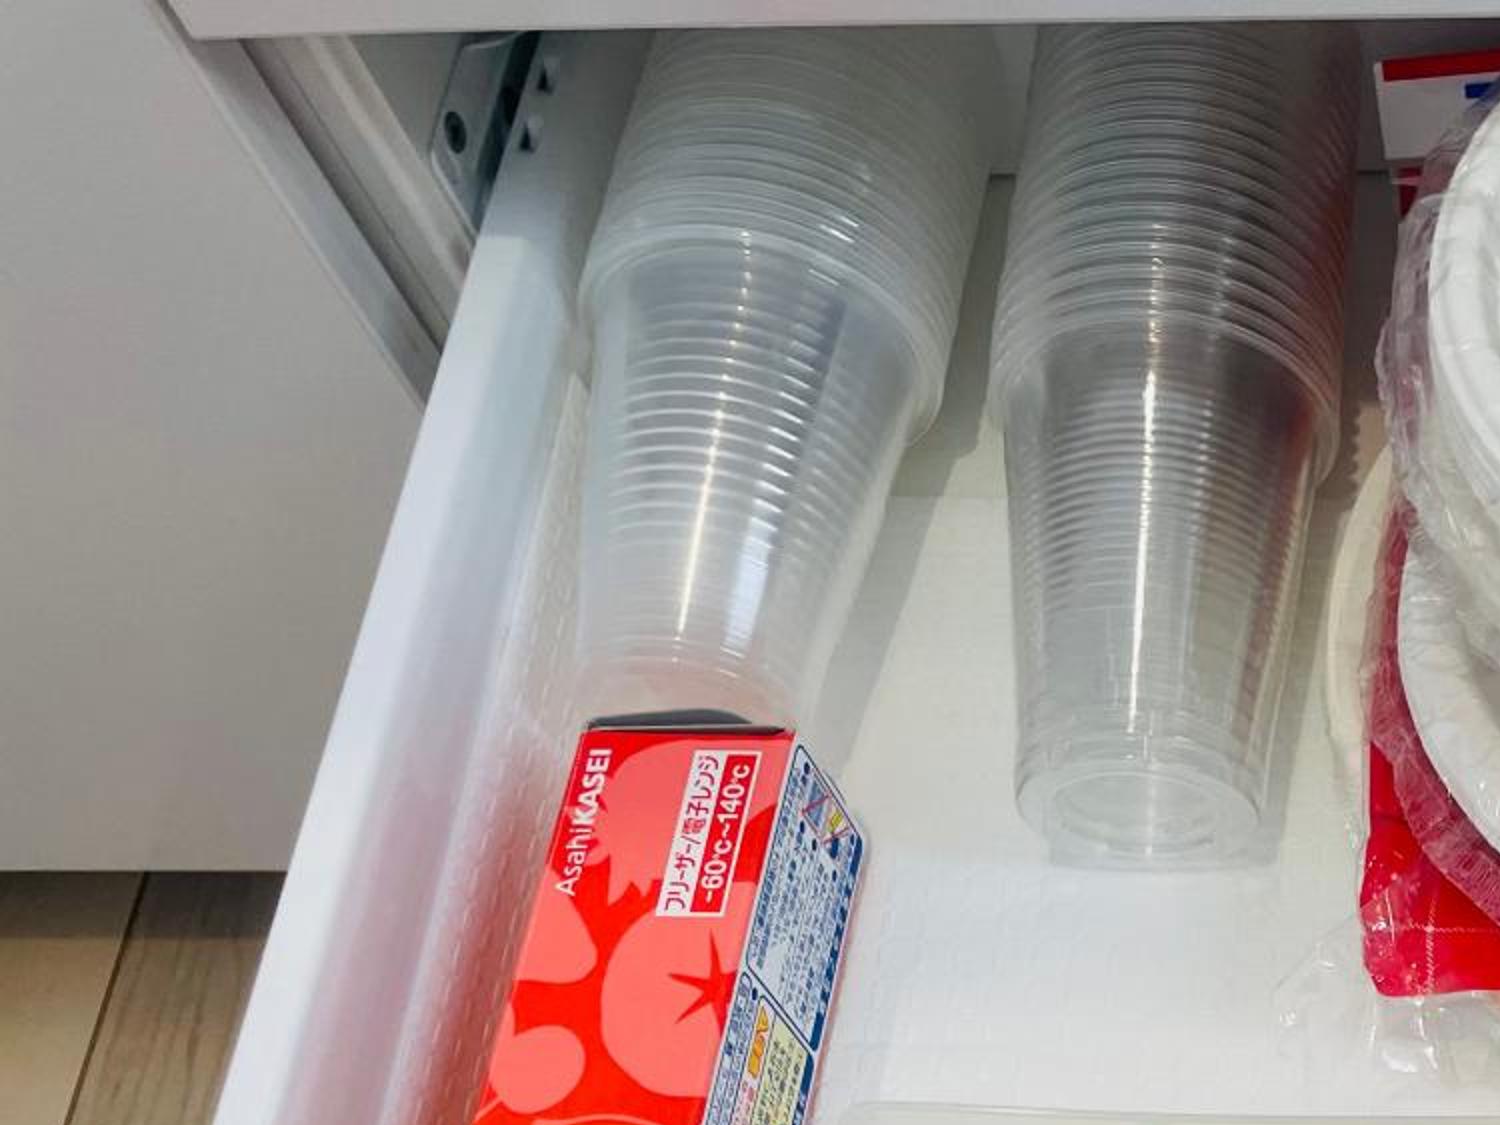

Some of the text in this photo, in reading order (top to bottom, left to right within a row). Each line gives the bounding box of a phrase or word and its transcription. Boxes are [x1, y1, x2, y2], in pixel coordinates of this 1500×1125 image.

[663, 754, 720, 913] フリーザー/電子レンジ
